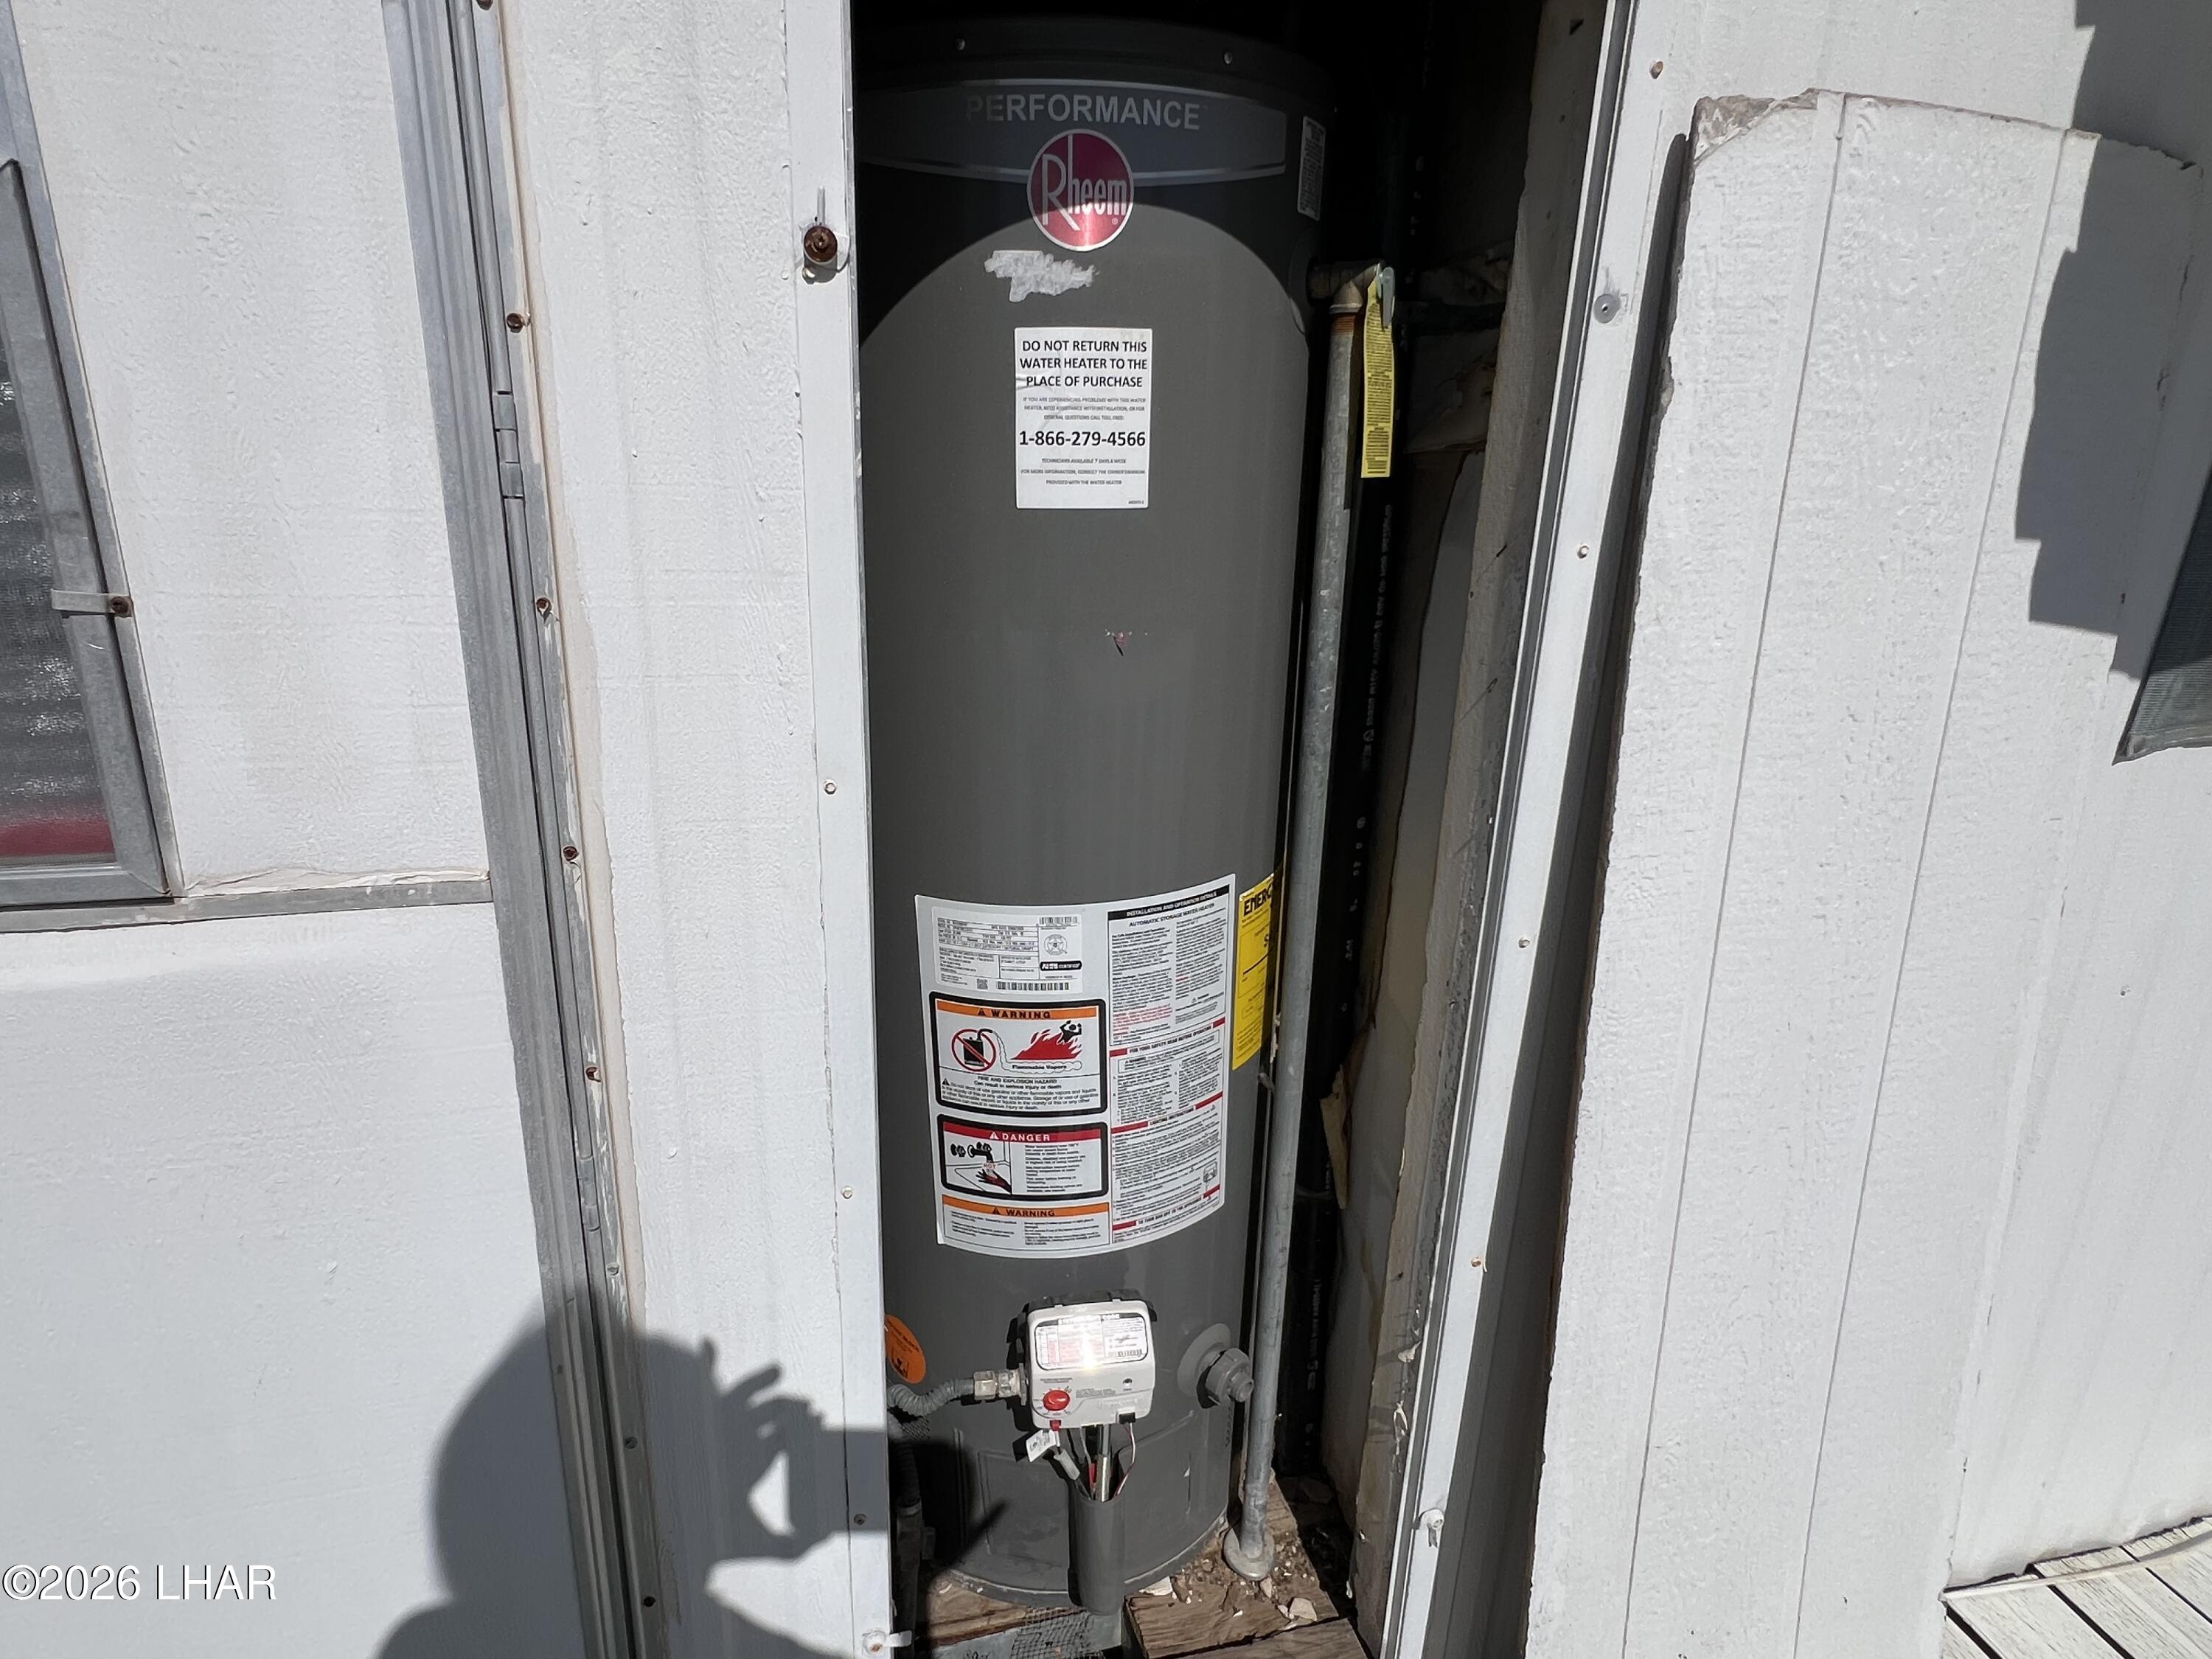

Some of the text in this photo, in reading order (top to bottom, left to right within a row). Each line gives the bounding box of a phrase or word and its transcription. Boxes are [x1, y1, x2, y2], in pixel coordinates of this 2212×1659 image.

[967, 94, 1200, 130] PERFORMANCE
[1042, 133, 1127, 230] Rheem
[1023, 341, 1147, 352] DO NOT RETURN THIS
[1020, 358, 1147, 369] WATER HEATER TO THE
[1026, 376, 1143, 387] PLACE OF PURCHASE
[1019, 431, 1146, 446] 1-866-279-4566
[990, 1009, 1051, 1019] WARNING
[1002, 1133, 1051, 1141] DANGER
[1006, 1208, 1055, 1217] WARNING
